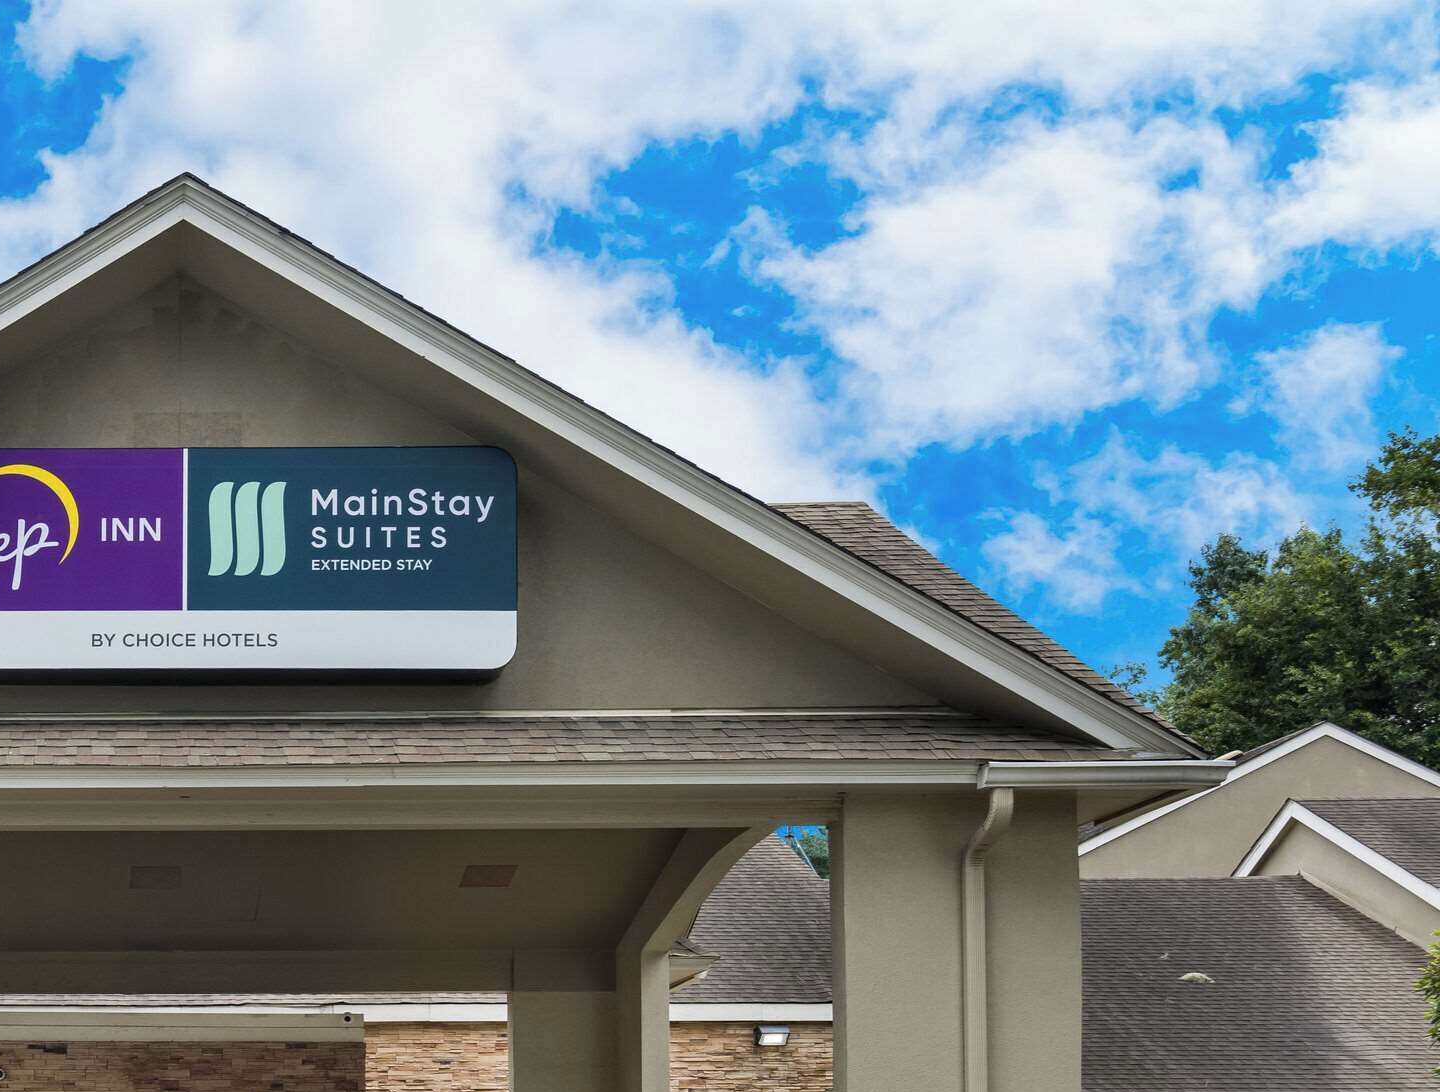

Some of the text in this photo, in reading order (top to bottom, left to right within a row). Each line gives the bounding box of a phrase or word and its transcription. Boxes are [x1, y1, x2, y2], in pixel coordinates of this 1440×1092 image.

[311, 488, 495, 523] MainStay
[101, 517, 161, 542] INN
[311, 526, 448, 549] SUITES
[311, 559, 433, 571] EXTENDED STAY
[91, 633, 278, 648] BY CHOICE HOTELS
